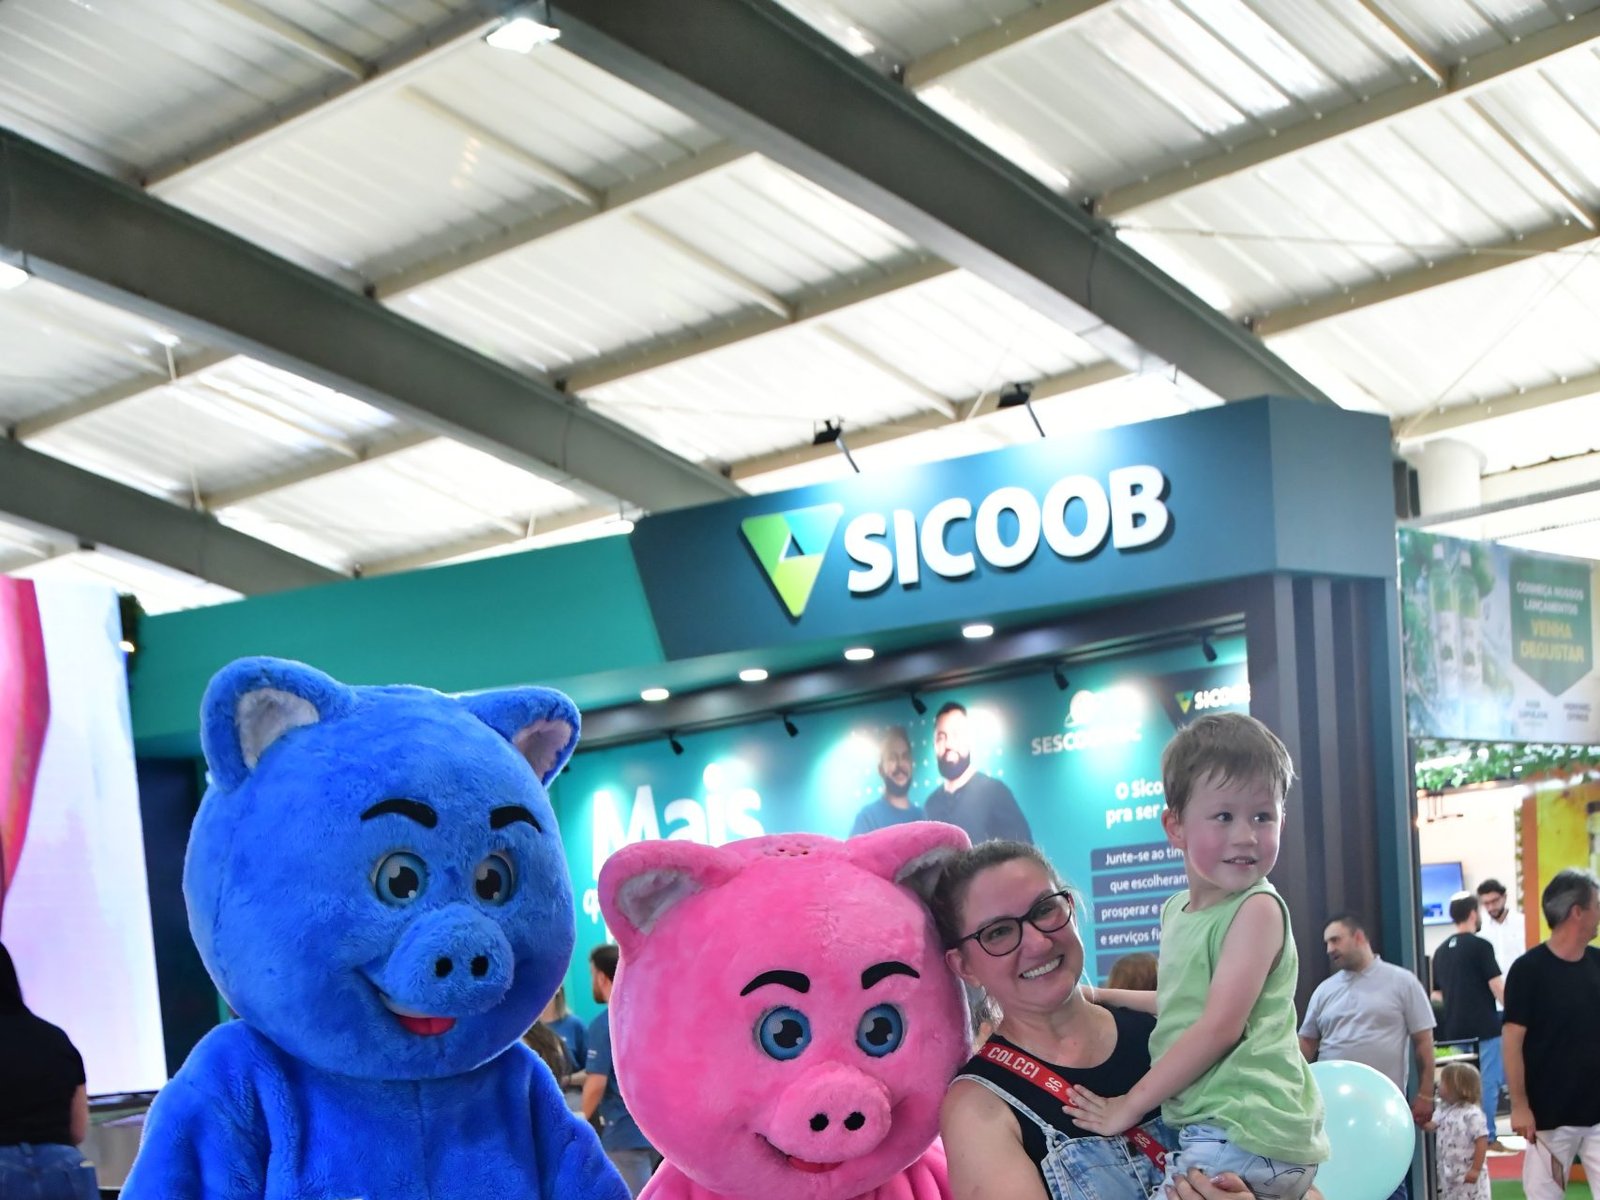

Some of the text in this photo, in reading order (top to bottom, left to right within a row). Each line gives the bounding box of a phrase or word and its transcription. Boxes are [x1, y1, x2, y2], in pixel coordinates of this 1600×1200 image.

[844, 464, 1169, 593] SICOOB
[1532, 621, 1573, 639] VENHA
[1520, 641, 1584, 663] DEGUSTAR
[1115, 778, 1164, 801] O Sico
[592, 762, 766, 881] Mais
[1105, 804, 1160, 829] pra ser
[1105, 846, 1185, 866] Junte-se ao tim
[1110, 873, 1189, 893] que escolheram
[1101, 903, 1150, 921] prosperar
[1151, 904, 1159, 915] e
[1100, 936, 1108, 946] e
[1109, 930, 1149, 946] serviços
[987, 1046, 1040, 1079] COLCCI
